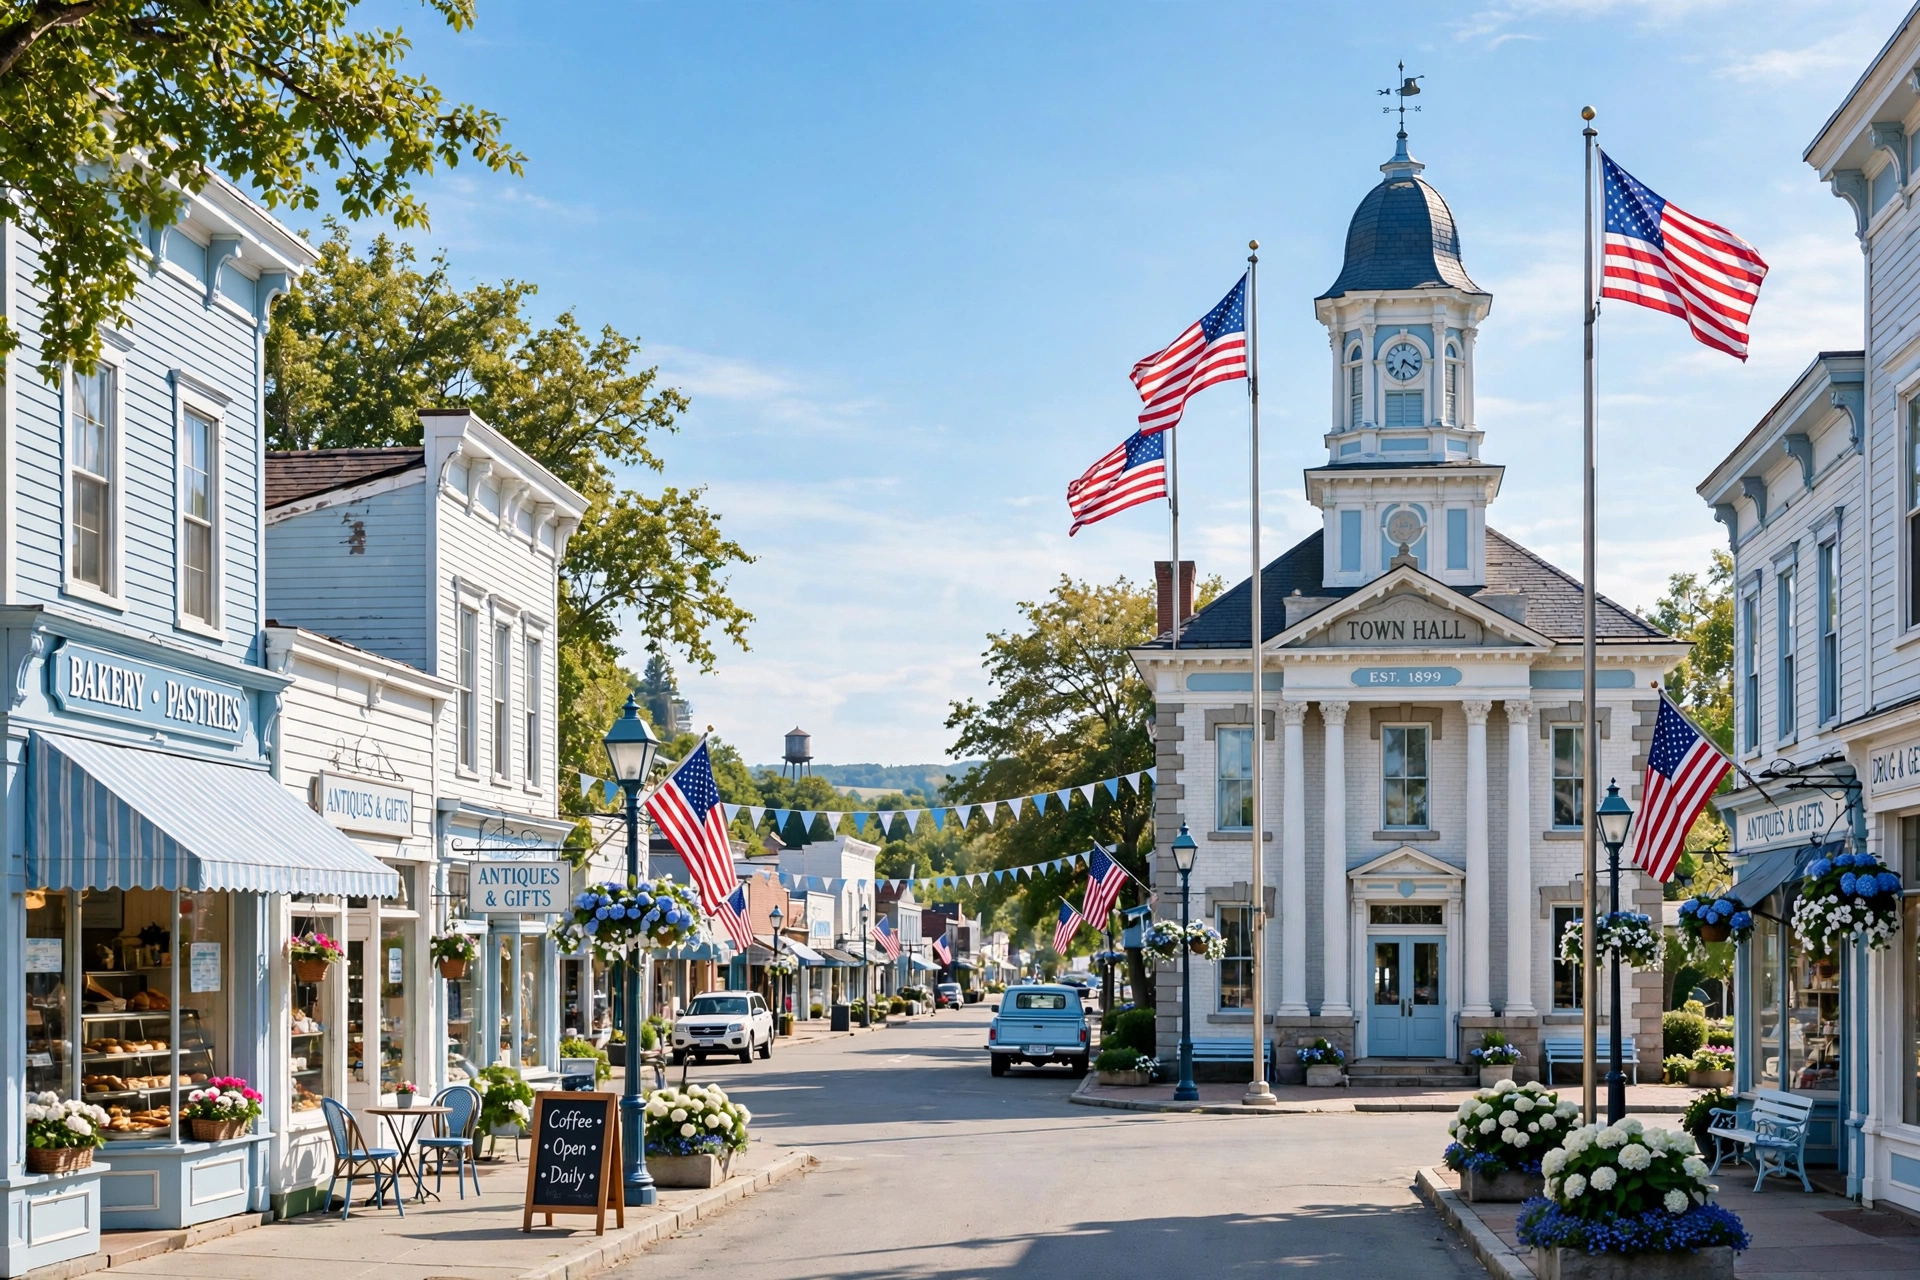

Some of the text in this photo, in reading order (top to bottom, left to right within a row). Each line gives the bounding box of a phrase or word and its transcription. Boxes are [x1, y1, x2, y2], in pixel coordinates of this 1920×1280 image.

[1347, 619, 1466, 640] TOWN HALL
[1369, 671, 1442, 683] EST. 1899
[69, 655, 241, 733] BAKERY PASTRIES
[1898, 750, 1904, 778] &
[326, 787, 409, 823] ANTIQUES & GIFTS
[1746, 801, 1824, 842] ANTIQUES & GIFTS
[478, 867, 560, 887] ANTIQUES
[485, 889, 551, 907] & GIFTS
[549, 1109, 593, 1130] Coffee
[553, 1137, 586, 1161] Open
[550, 1165, 586, 1191] Daily
